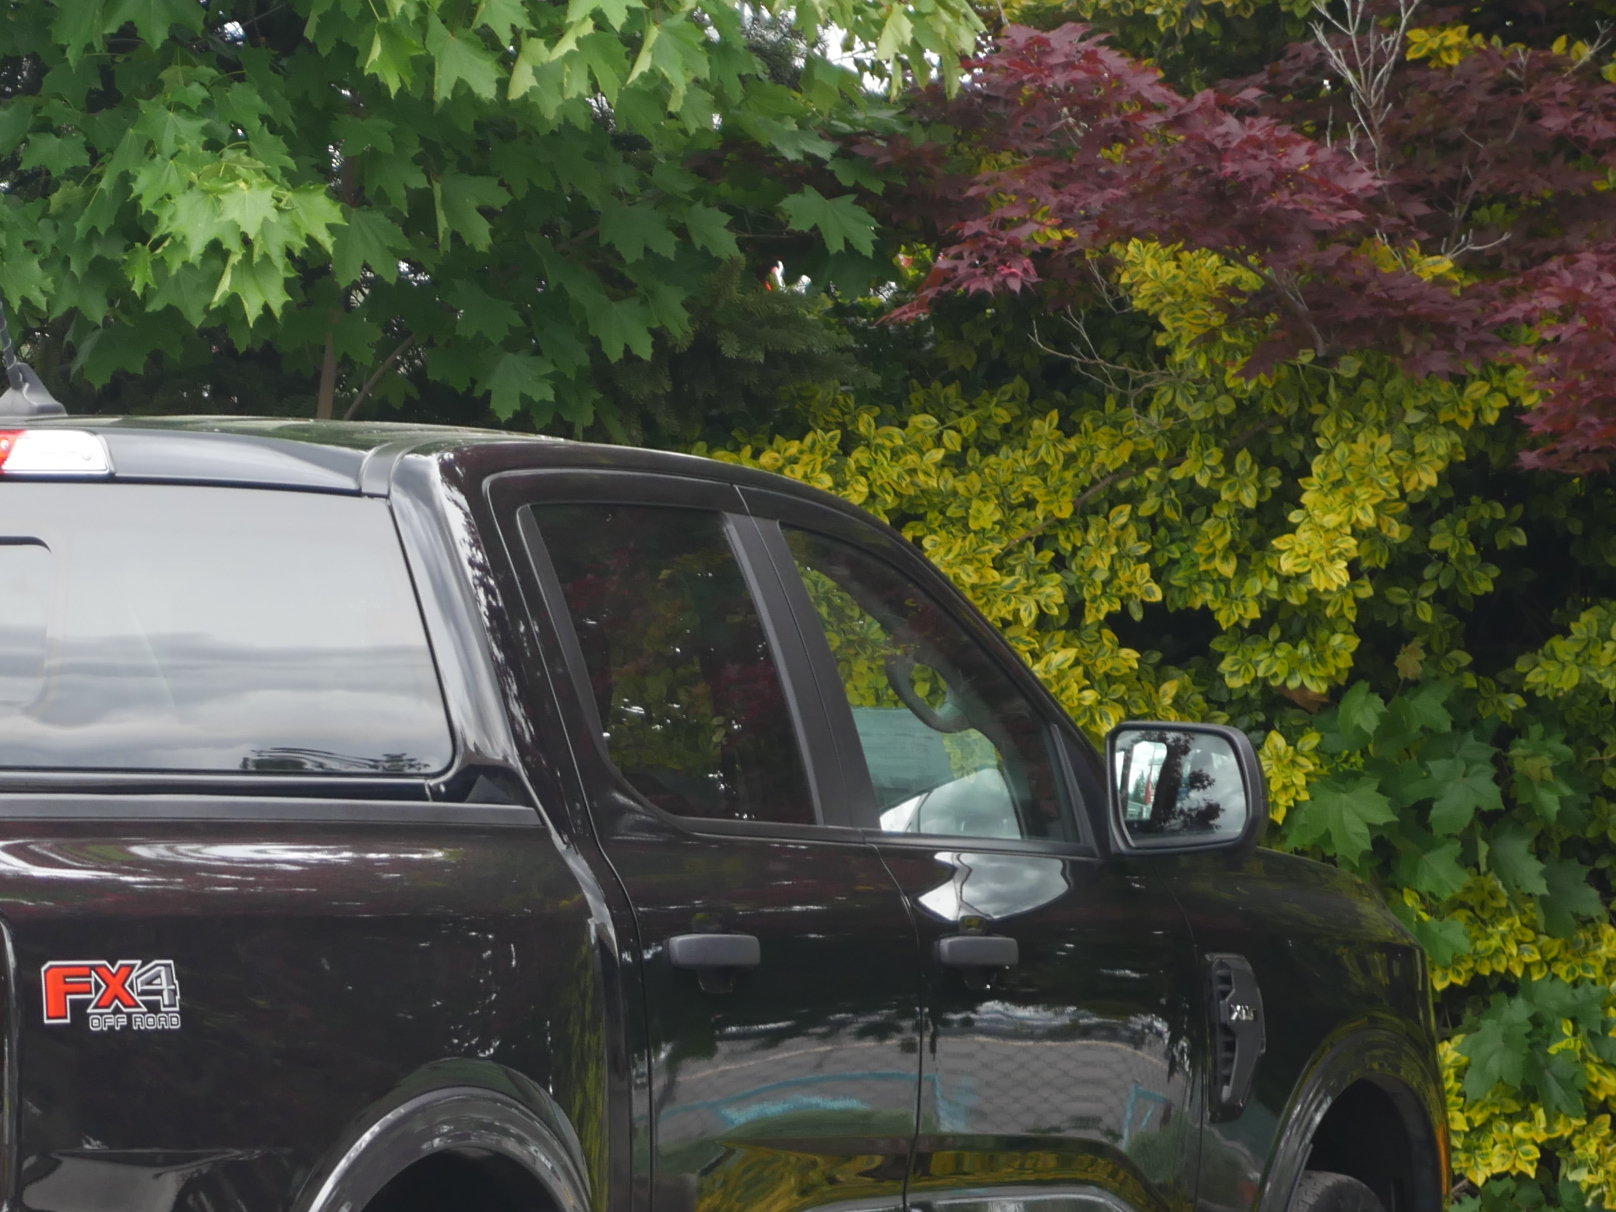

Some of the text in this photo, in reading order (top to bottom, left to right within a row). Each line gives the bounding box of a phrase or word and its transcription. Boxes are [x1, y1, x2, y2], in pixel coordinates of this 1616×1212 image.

[41, 960, 180, 1024] FX4
[89, 1013, 181, 1031] OFF ROAD
